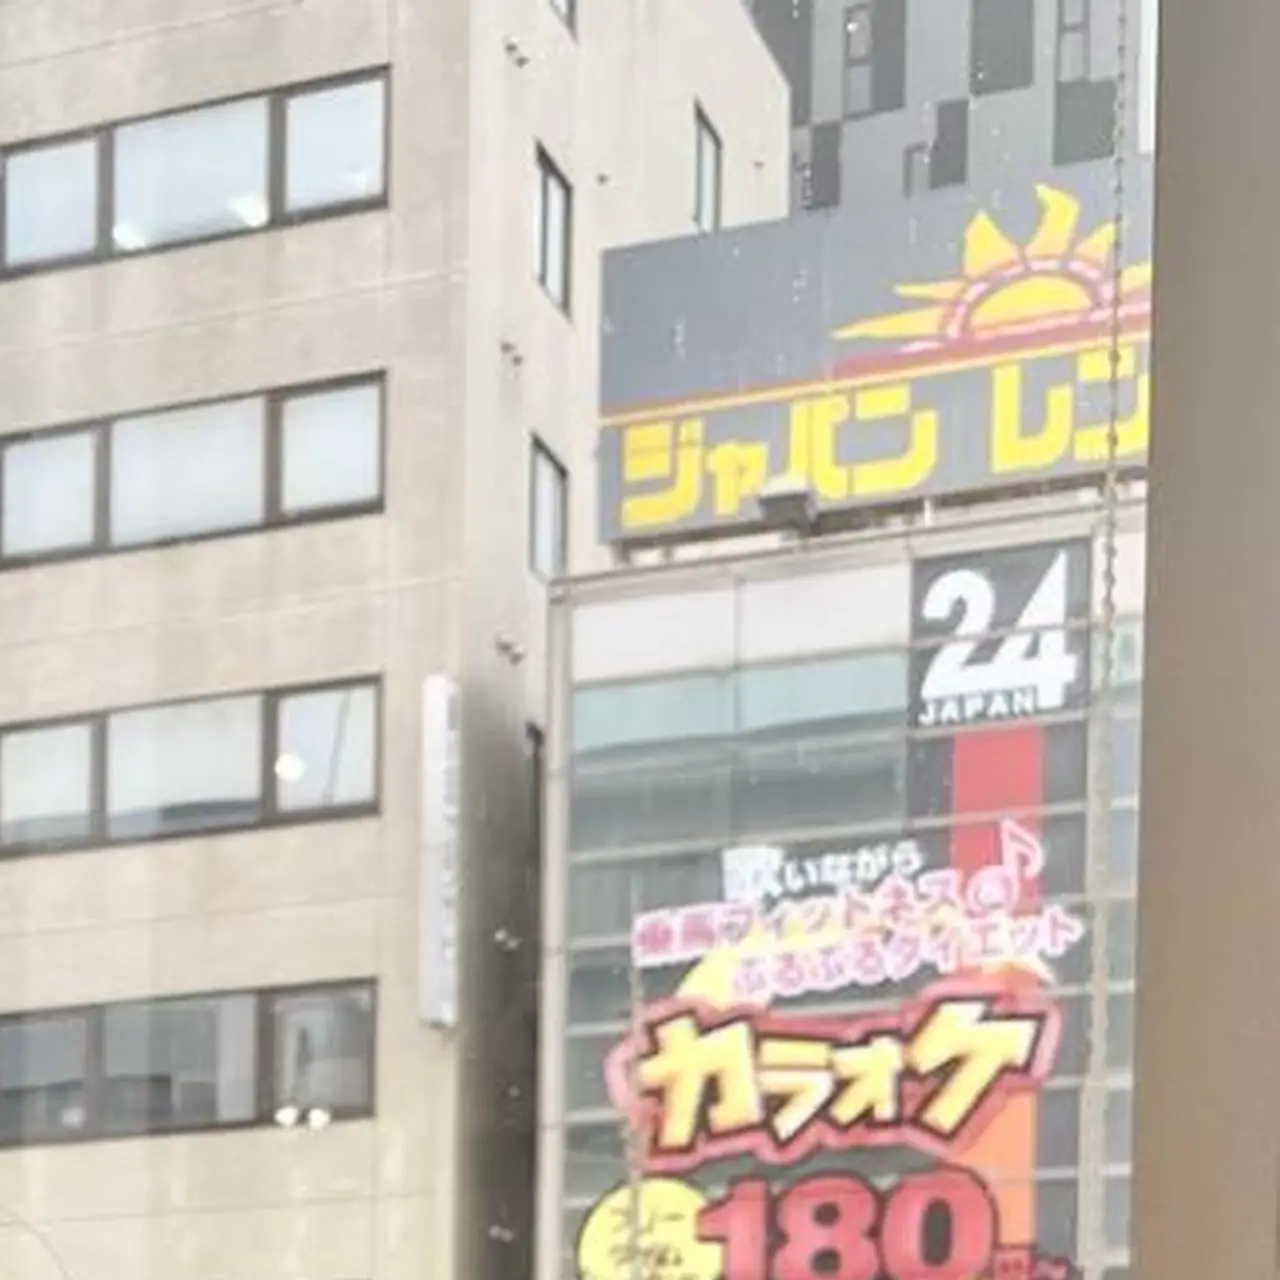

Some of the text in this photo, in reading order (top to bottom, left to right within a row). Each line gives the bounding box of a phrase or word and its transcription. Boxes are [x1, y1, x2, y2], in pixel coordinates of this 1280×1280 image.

[619, 380, 938, 528] ジャパン
[920, 549, 1078, 708] 24
[918, 692, 1037, 726] JAPAN
[637, 999, 1045, 1152] カラオケ
